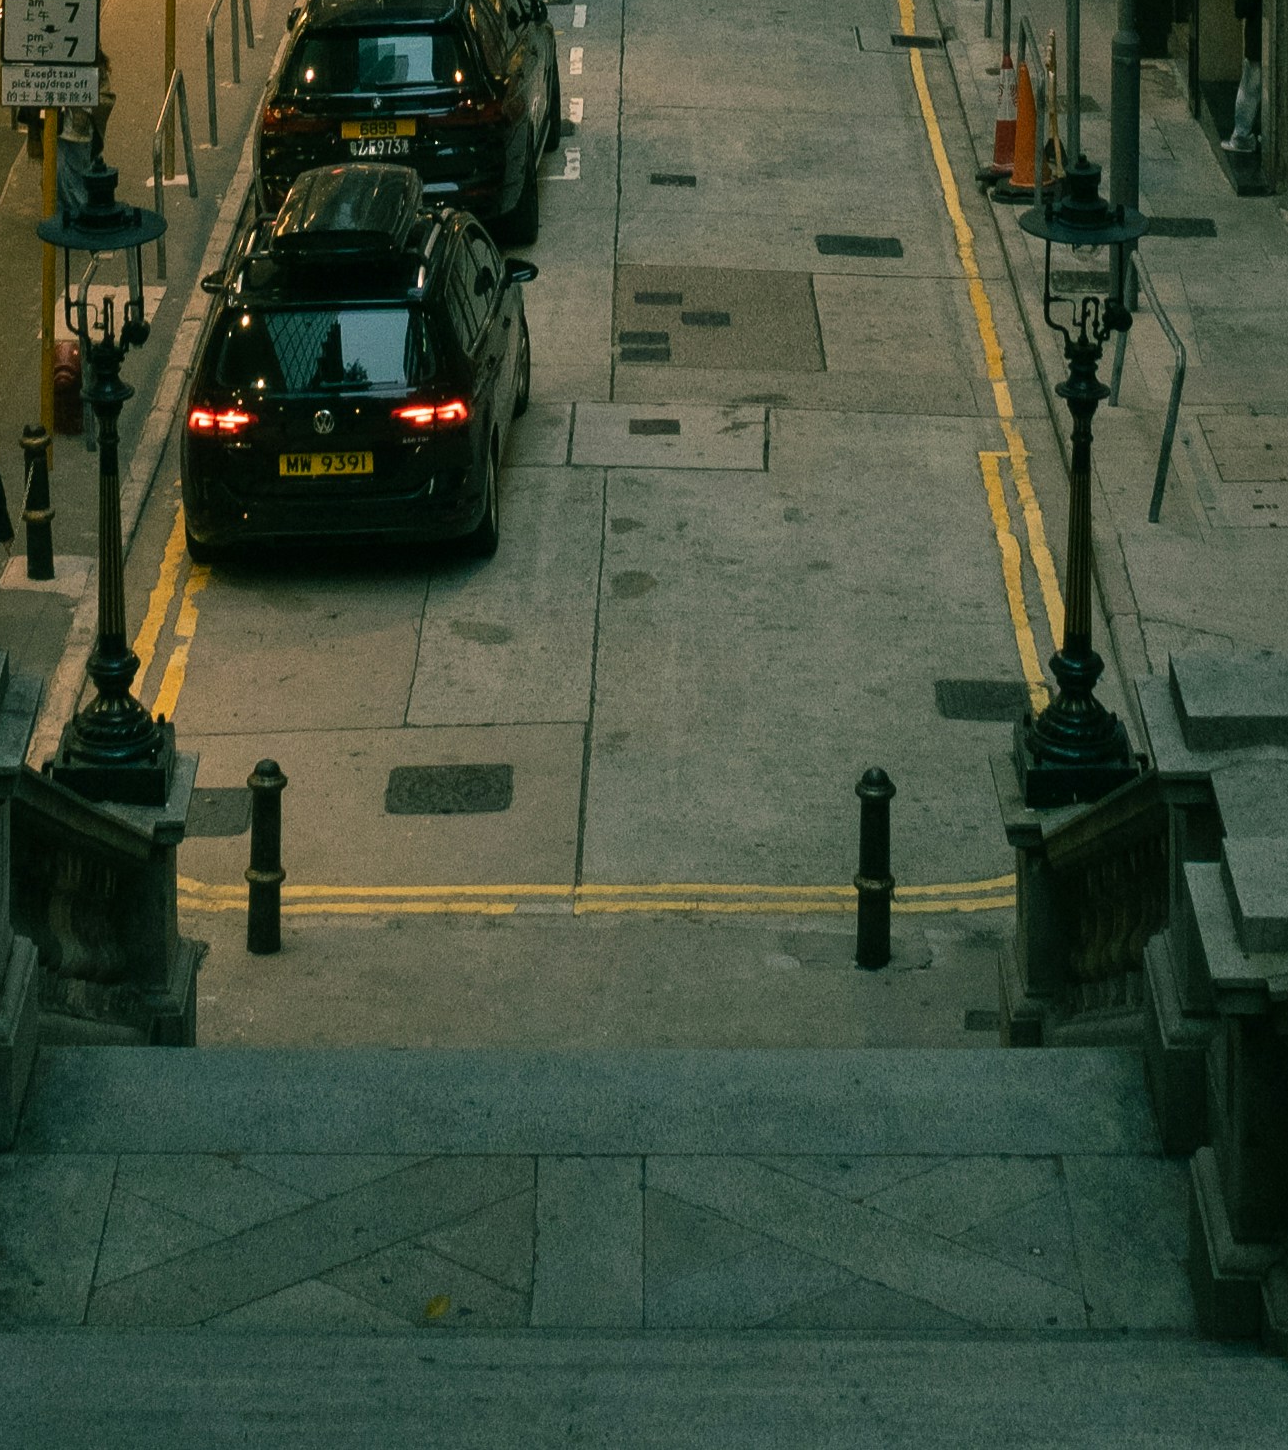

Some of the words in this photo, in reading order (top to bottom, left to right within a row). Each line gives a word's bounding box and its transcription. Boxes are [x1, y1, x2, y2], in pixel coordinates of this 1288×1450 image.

[23, 9, 50, 22] 上午
[64, 2, 80, 23] 7
[27, 33, 44, 43] pm
[22, 44, 49, 57] 下午
[64, 37, 79, 58] 7
[24, 68, 56, 80] Except
[59, 69, 77, 79] taxi
[12, 78, 31, 89] pick
[34, 78, 71, 90] up/drop
[74, 78, 88, 89] off
[286, 459, 311, 474] MW
[320, 455, 367, 473] 9391
